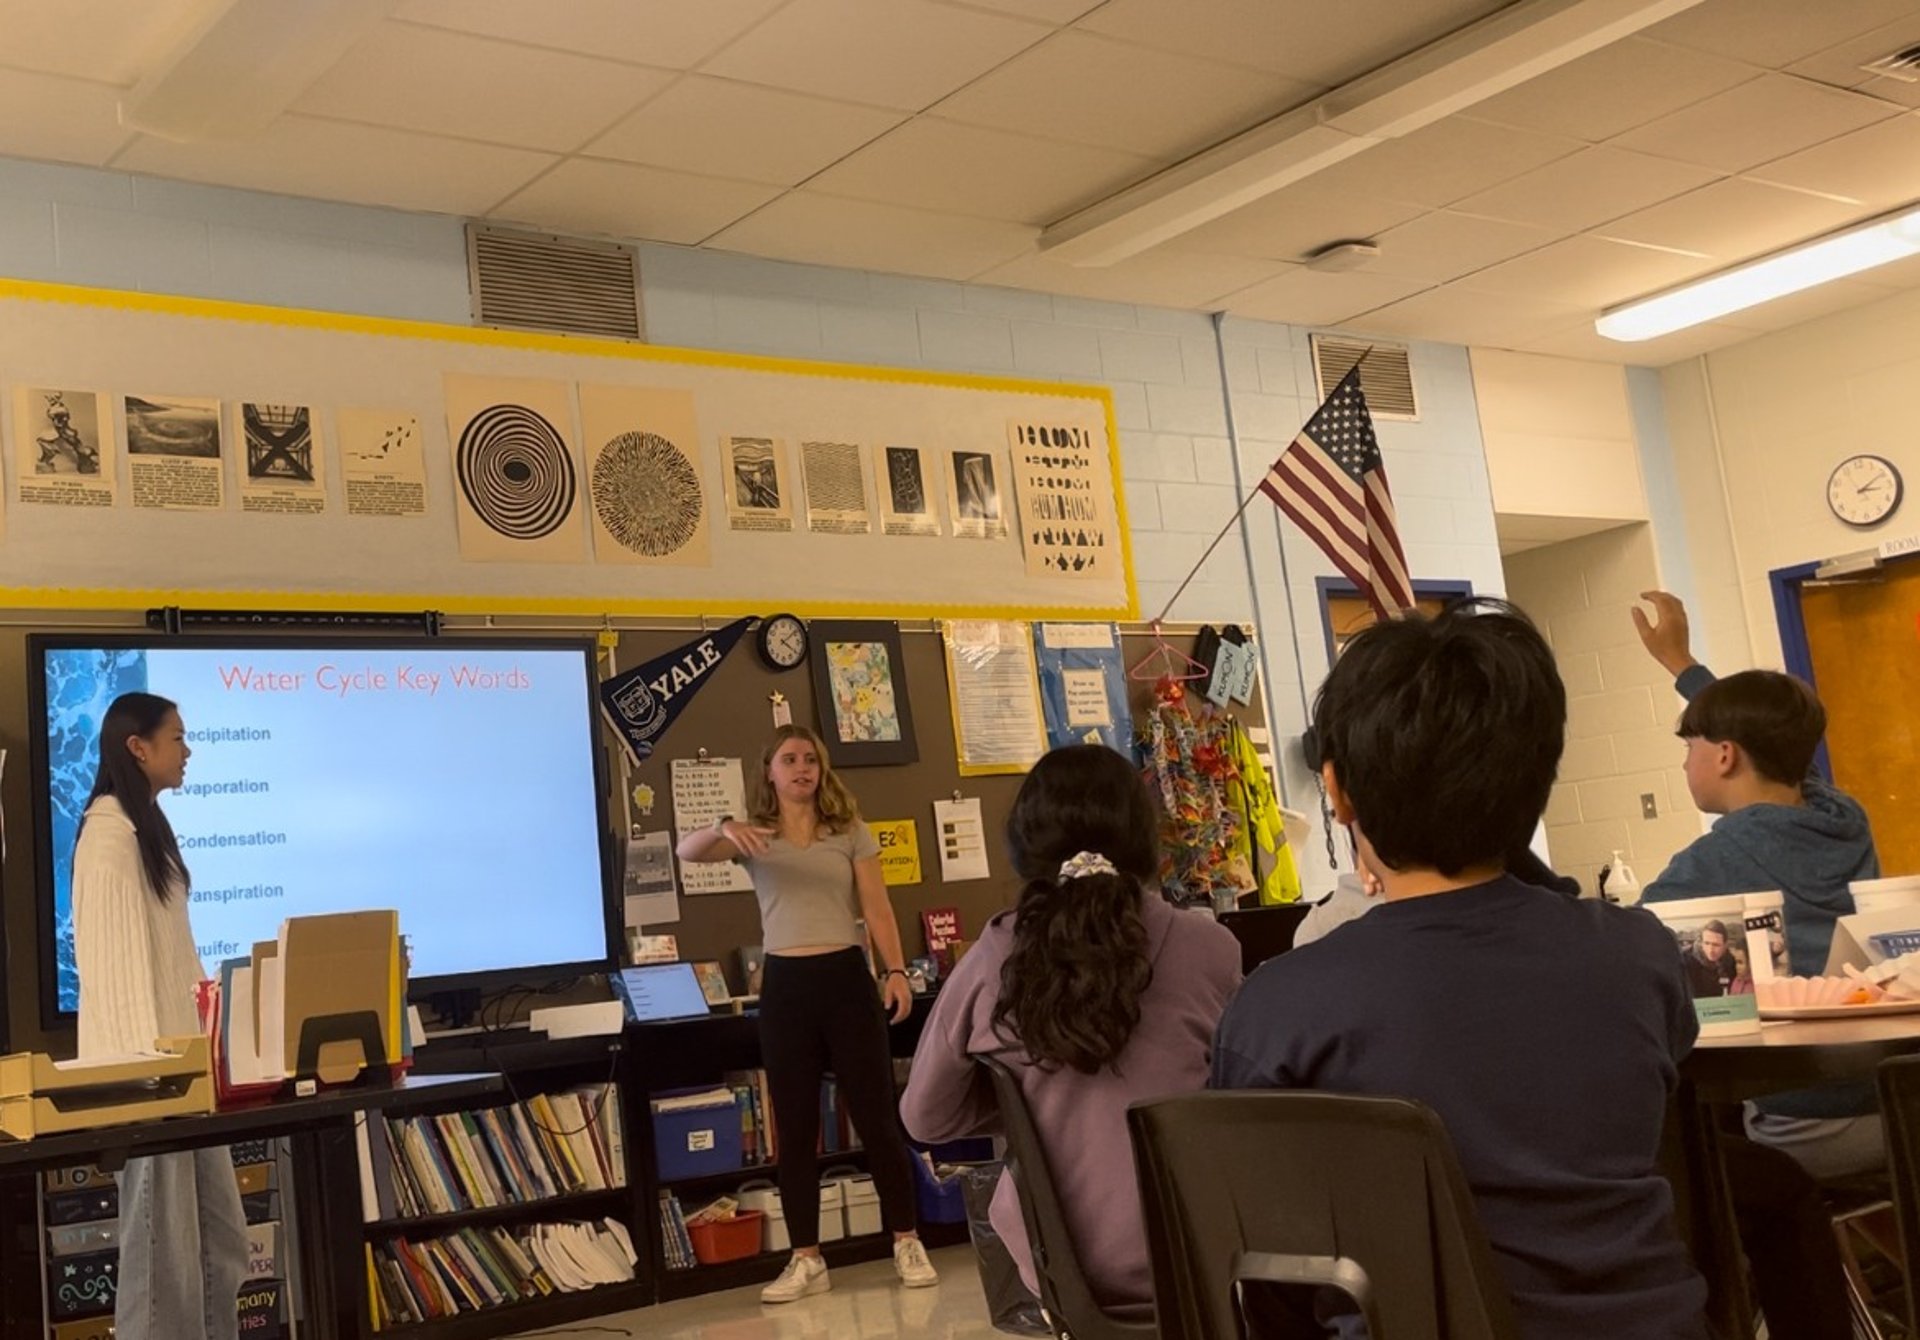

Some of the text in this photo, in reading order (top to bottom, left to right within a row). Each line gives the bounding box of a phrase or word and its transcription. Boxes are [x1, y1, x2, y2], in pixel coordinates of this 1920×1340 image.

[649, 638, 723, 702] YALE
[219, 665, 530, 697] Water Cycle Key Words
[184, 727, 272, 744] ecipitation
[176, 830, 286, 849] Condensation
[189, 884, 284, 904] anspiration
[248, 1258, 273, 1274] PER
[236, 1291, 276, 1312] many
